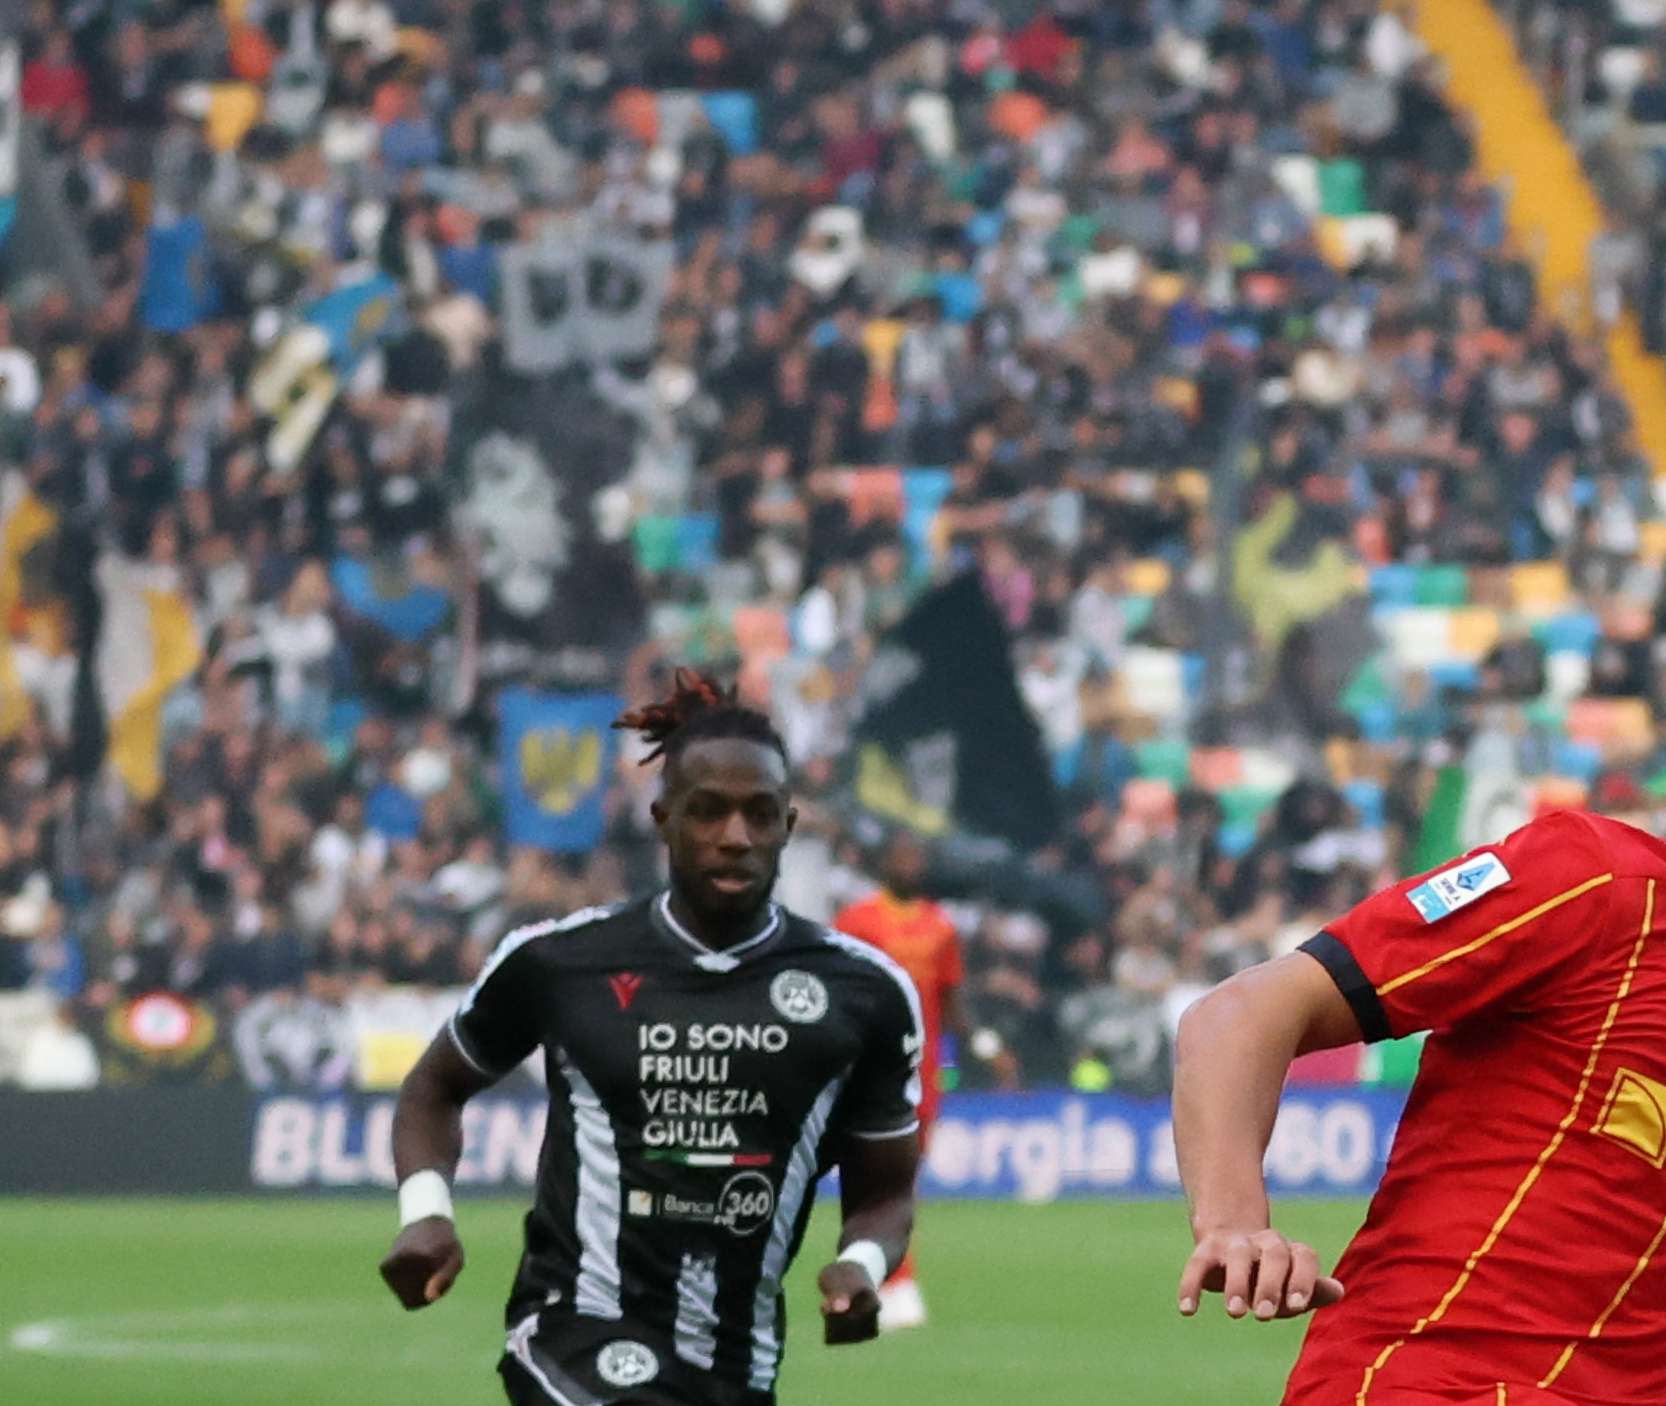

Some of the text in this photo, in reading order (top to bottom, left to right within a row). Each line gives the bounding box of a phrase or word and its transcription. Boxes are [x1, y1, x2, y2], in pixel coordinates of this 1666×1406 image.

[639, 1023, 788, 1052] IO SONO
[640, 1056, 730, 1083] FRIULI
[640, 1088, 769, 1115] VENEZIA
[642, 1119, 740, 1148] GIULIA
[927, 1101, 1136, 1204] ergia
[1262, 1102, 1371, 1184] 60
[664, 1191, 771, 1217] Banca 360
